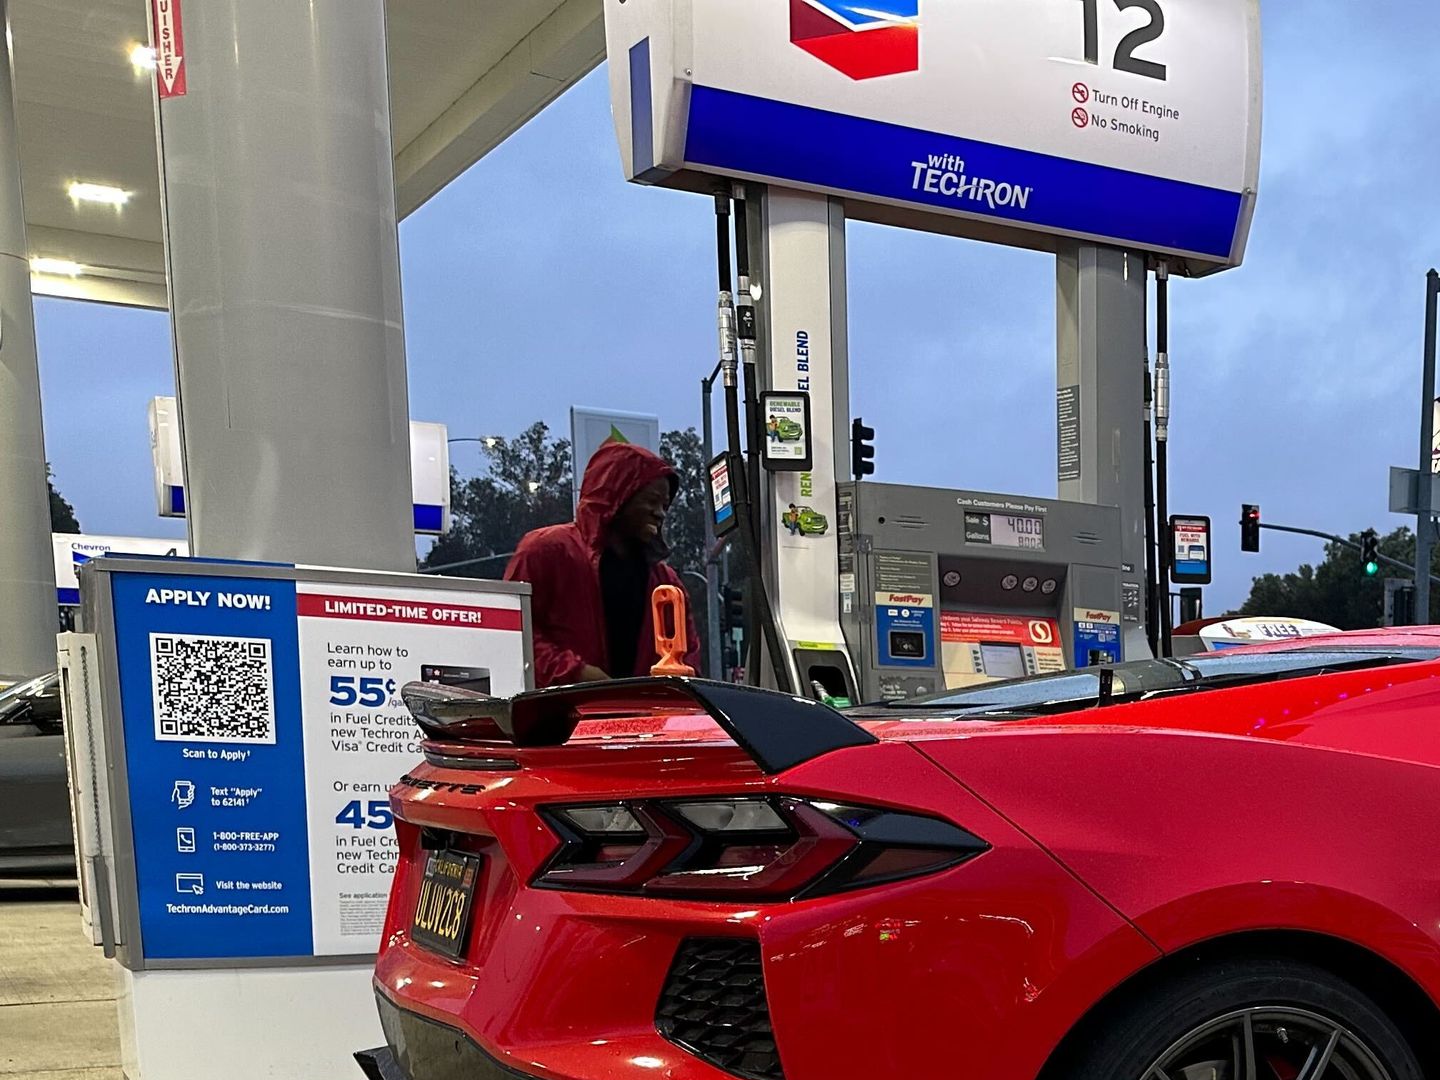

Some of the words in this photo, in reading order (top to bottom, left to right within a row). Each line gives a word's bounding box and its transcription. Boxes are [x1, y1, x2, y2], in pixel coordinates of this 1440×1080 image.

[1083, 0, 1166, 81] 12
[1092, 89, 1118, 106] Turn
[1121, 96, 1139, 111] Off
[1142, 101, 1180, 120] Engine
[1091, 114, 1107, 129] No
[1110, 118, 1160, 142] Smoking
[928, 153, 965, 173] with
[911, 161, 1030, 210] TECHRON
[796, 330, 809, 372] BLEND
[956, 498, 972, 506] Cash
[972, 499, 1005, 509] Customers
[1005, 502, 1024, 511] Please
[1024, 504, 1034, 512] Pay
[1034, 505, 1048, 513] First
[1007, 517, 1041, 535] 40.00
[71, 542, 111, 552] Chevron
[145, 588, 211, 606] APPLY
[217, 592, 271, 611] NOW!
[888, 594, 924, 606] FastPay
[325, 600, 428, 620] LIMITED-TIME
[431, 608, 482, 624] OFFER!
[1085, 611, 1112, 622] FastPay
[1256, 623, 1302, 638] FREE
[327, 642, 364, 655] Learn
[367, 645, 393, 657] how
[396, 646, 409, 658] to
[327, 658, 357, 669] earn
[360, 661, 376, 672] up
[379, 661, 392, 671] to
[330, 713, 341, 724] in
[346, 713, 371, 725] Fuel
[374, 715, 417, 727] Credits
[331, 729, 356, 738] new
[361, 728, 410, 740] Techron
[183, 748, 205, 759] Scan
[208, 749, 218, 759] to
[366, 742, 403, 754] Credit
[407, 743, 425, 754] Ca
[211, 787, 228, 796] Text
[333, 781, 348, 792] Or
[353, 782, 381, 792] earn
[211, 798, 220, 806] to
[335, 800, 393, 829] 45
[213, 832, 279, 841] 1-800-FREE-APP
[336, 836, 347, 847] in
[351, 836, 376, 847] Fuel
[213, 843, 275, 852] (1-800-373-3277)
[336, 851, 362, 861] new
[337, 863, 375, 875] Credit
[216, 881, 234, 890] Visit
[236, 881, 250, 890] the
[252, 881, 283, 890] website
[339, 892, 352, 900] See
[353, 892, 387, 901] application
[166, 903, 289, 916] TechronAdvantageCard.com
